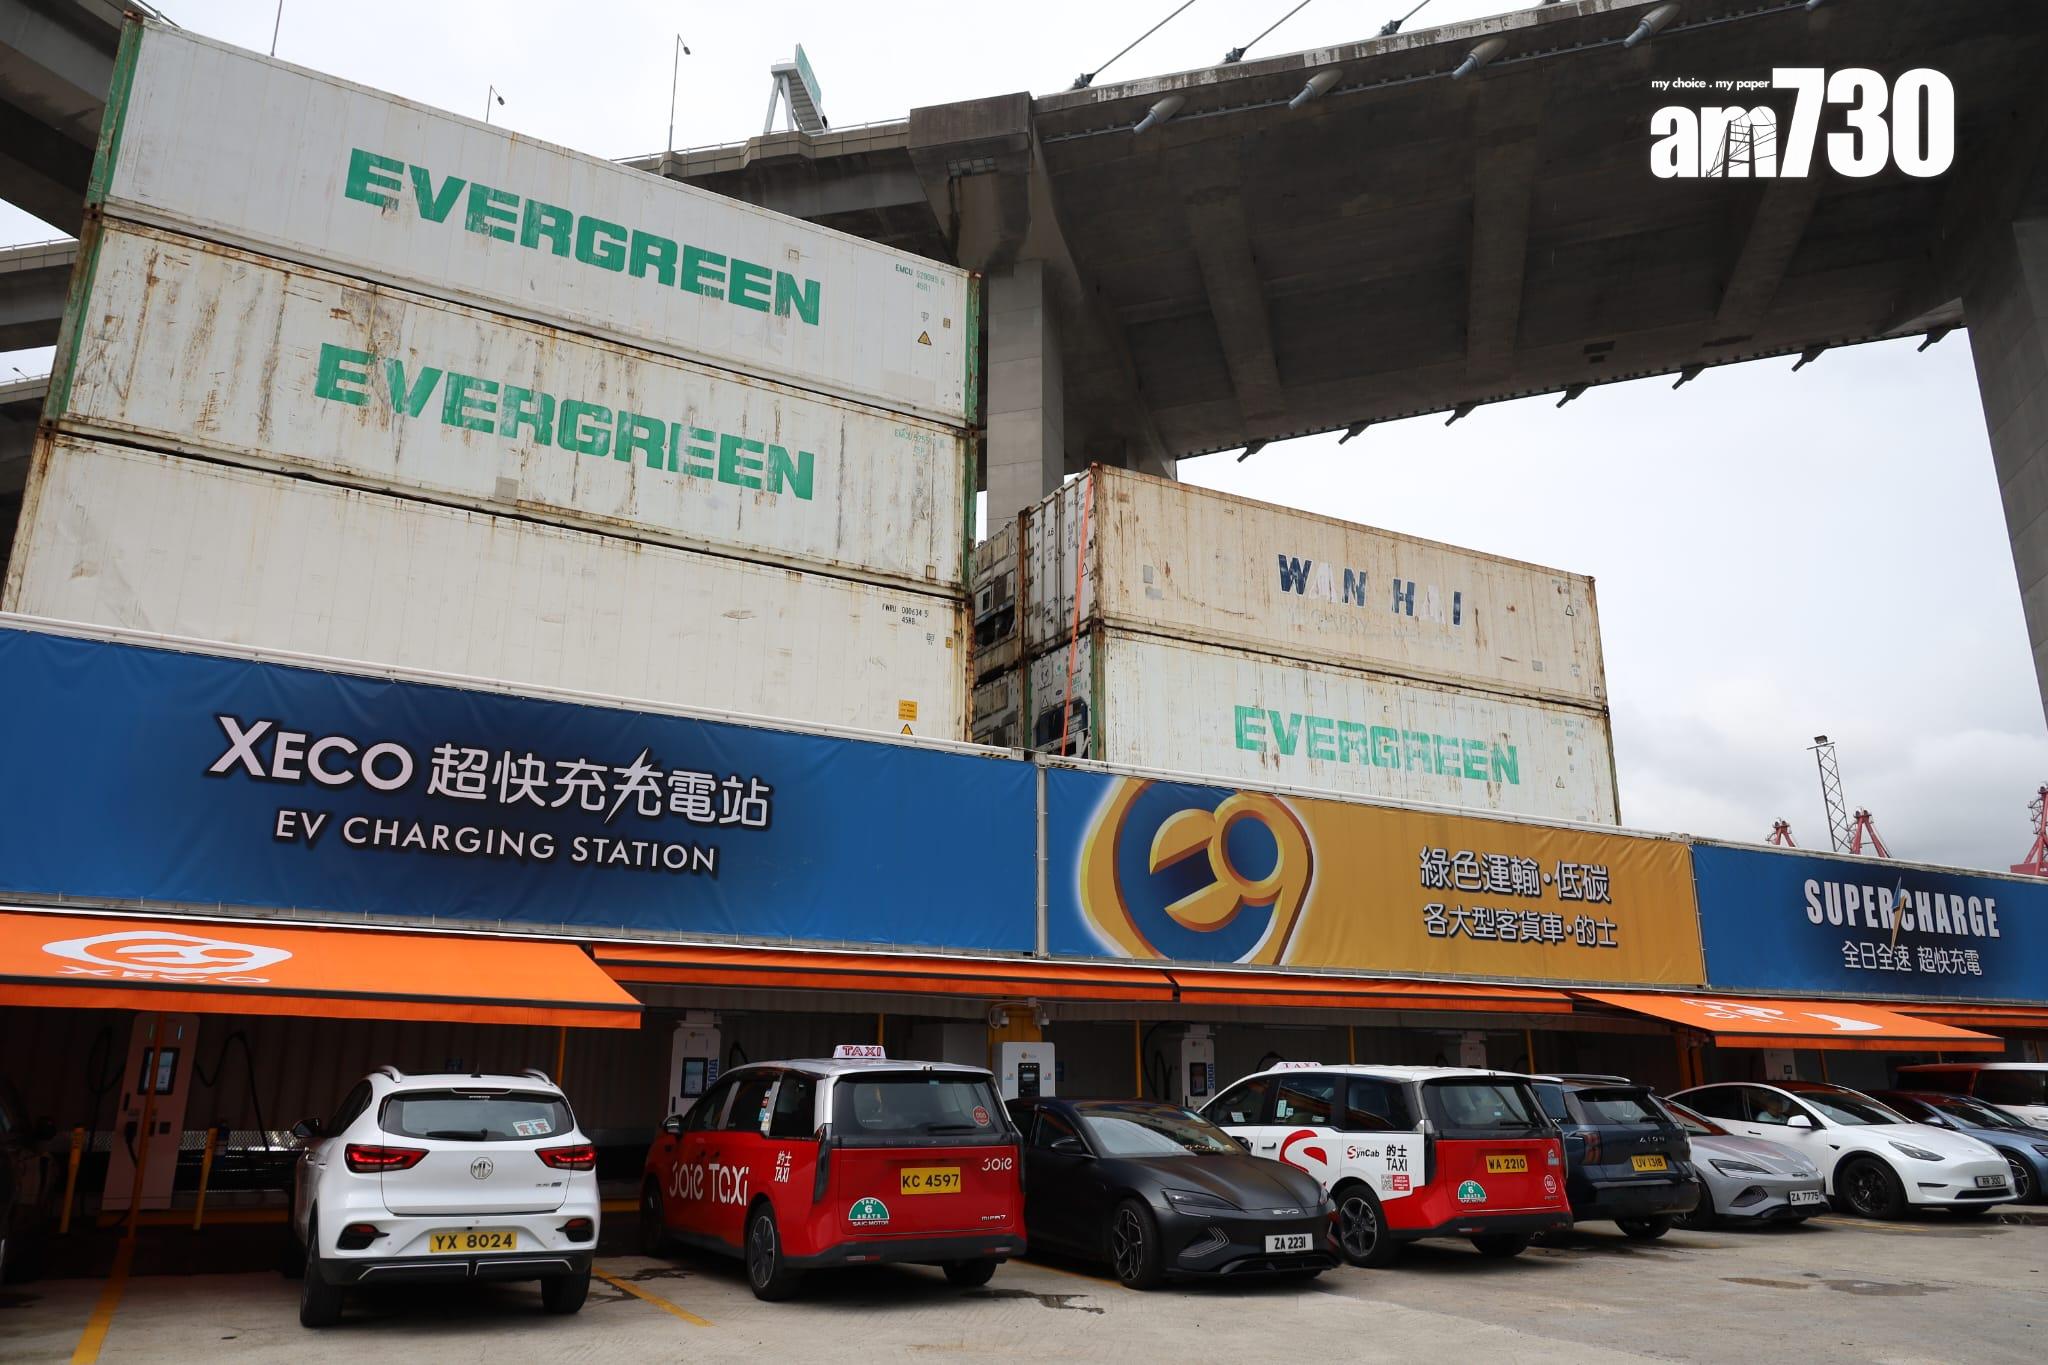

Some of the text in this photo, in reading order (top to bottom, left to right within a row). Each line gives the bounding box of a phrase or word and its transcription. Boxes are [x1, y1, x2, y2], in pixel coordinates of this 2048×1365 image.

[345, 148, 820, 326] EVERGREEN
[314, 343, 814, 500] EVERGREEN
[1278, 554, 1463, 625] WAN HAI
[1234, 705, 1520, 784] EVERGREEN
[210, 716, 413, 790] XECO
[276, 810, 715, 872] EV CHARGING STATION
[1842, 940, 1982, 976] 全日全速 超快充電
[843, 1046, 882, 1057] TAXI
[777, 1150, 792, 1166] 的士
[1346, 1146, 1380, 1159] SynCab
[1386, 1144, 1408, 1158] 的士
[473, 1159, 493, 1179] MG
[1386, 1158, 1408, 1171] TAXI
[1487, 1159, 1526, 1170] WA 2210
[774, 1166, 790, 1183] TAXI
[902, 1174, 960, 1189] KC 4597
[1467, 1186, 1474, 1194] 6
[1791, 1191, 1819, 1202] ZA 7775
[864, 1204, 873, 1214] 6
[435, 1233, 513, 1250] YX 8024
[1274, 1235, 1306, 1250] ZA 2231
